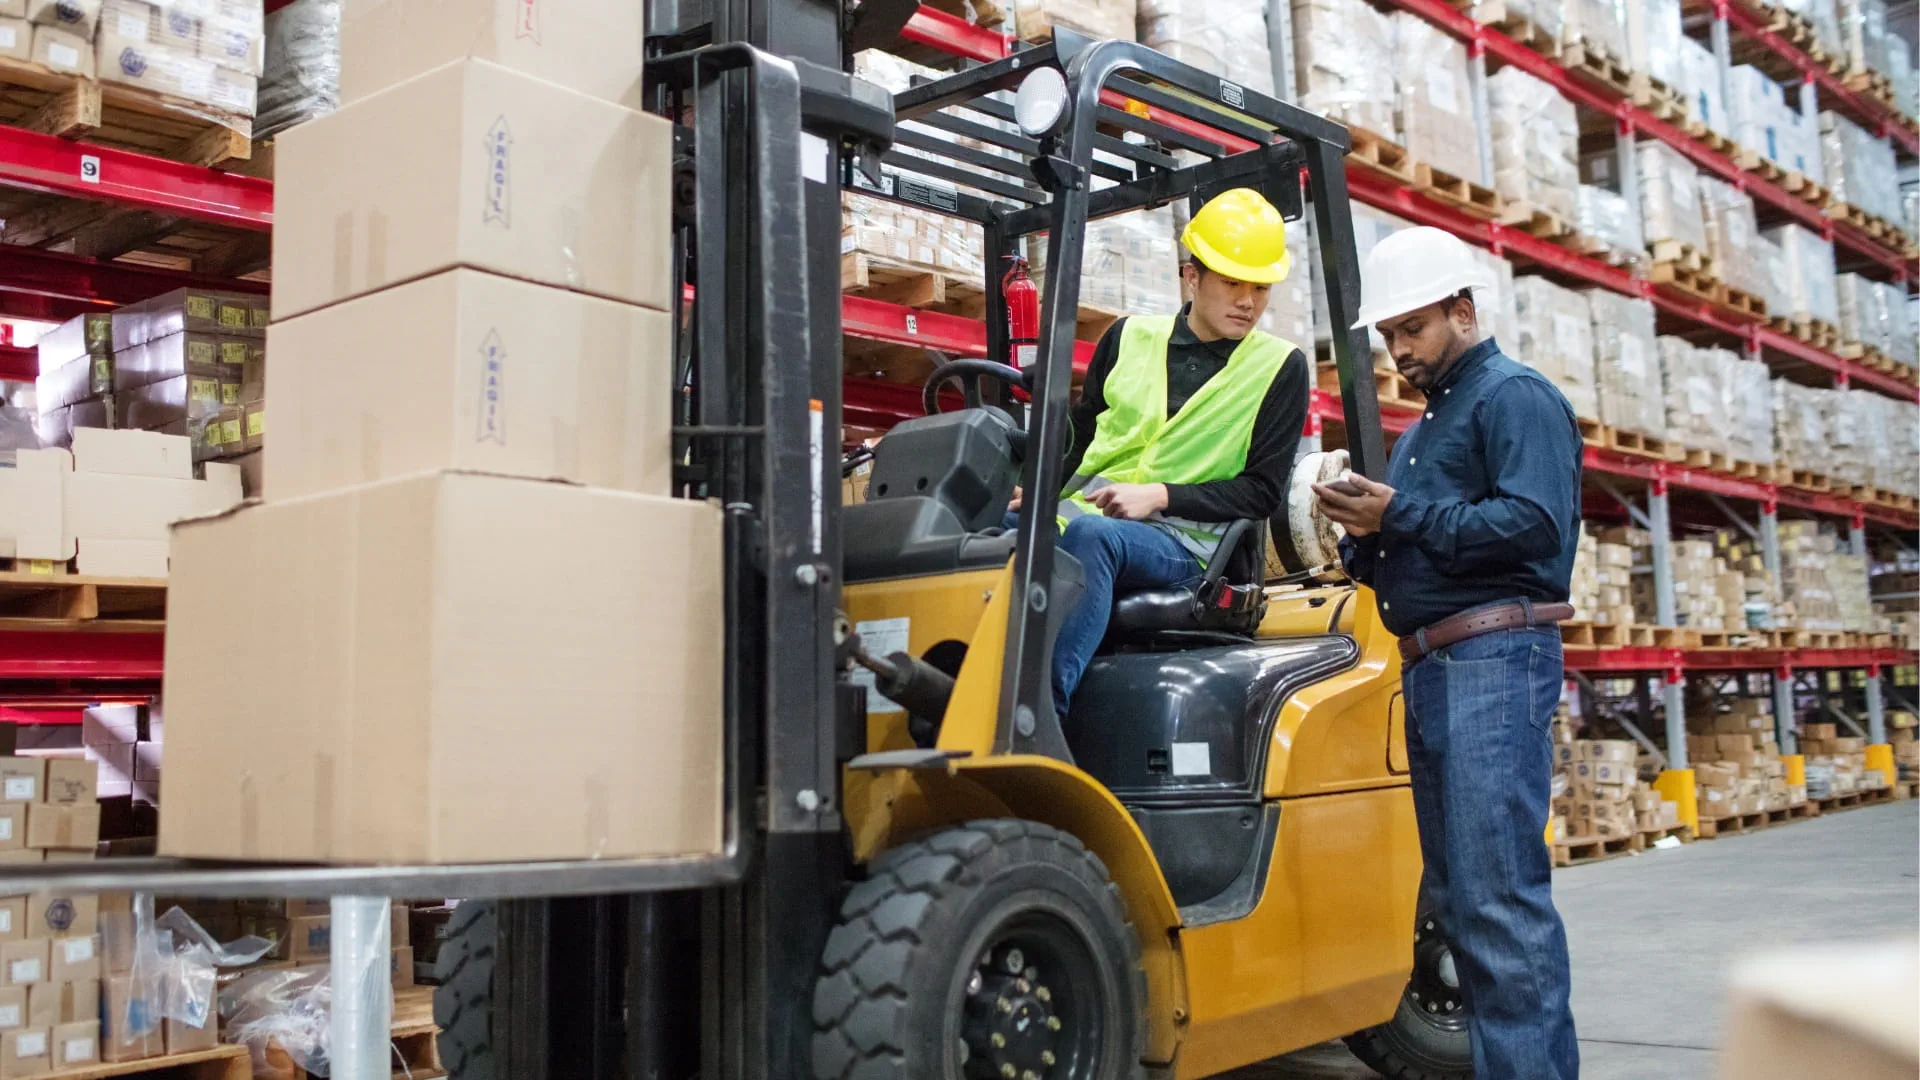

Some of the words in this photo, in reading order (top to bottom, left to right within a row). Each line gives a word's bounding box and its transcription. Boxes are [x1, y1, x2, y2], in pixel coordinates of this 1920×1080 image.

[83, 162, 97, 176] 9
[493, 131, 505, 213] FRAGIL
[908, 319, 917, 329] 12
[487, 346, 499, 431] FRAGIL
